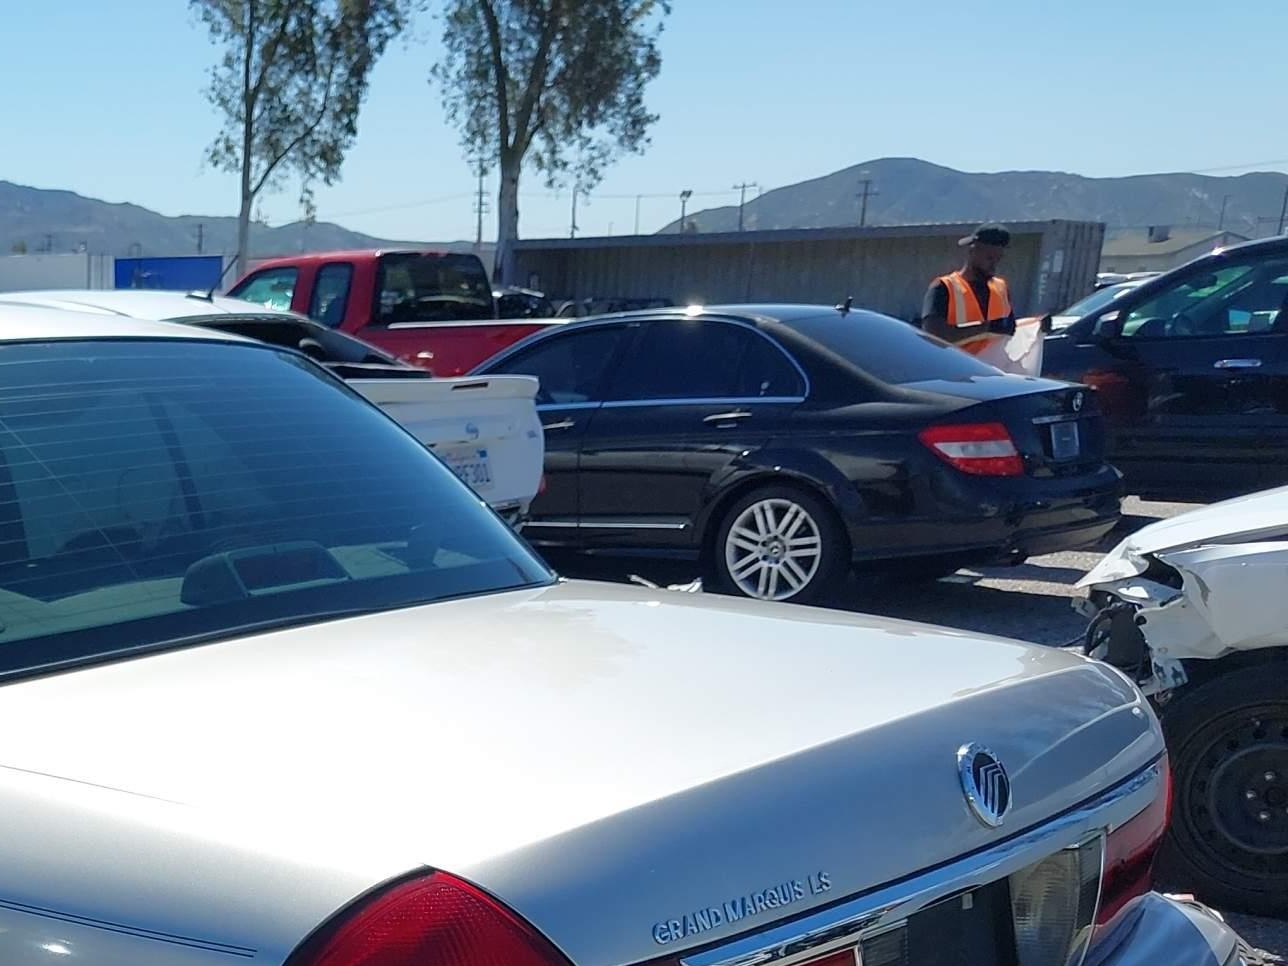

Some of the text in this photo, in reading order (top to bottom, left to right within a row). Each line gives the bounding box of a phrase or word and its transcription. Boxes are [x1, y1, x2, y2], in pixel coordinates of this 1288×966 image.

[652, 871, 832, 945] GRAND MARQUIS LS
